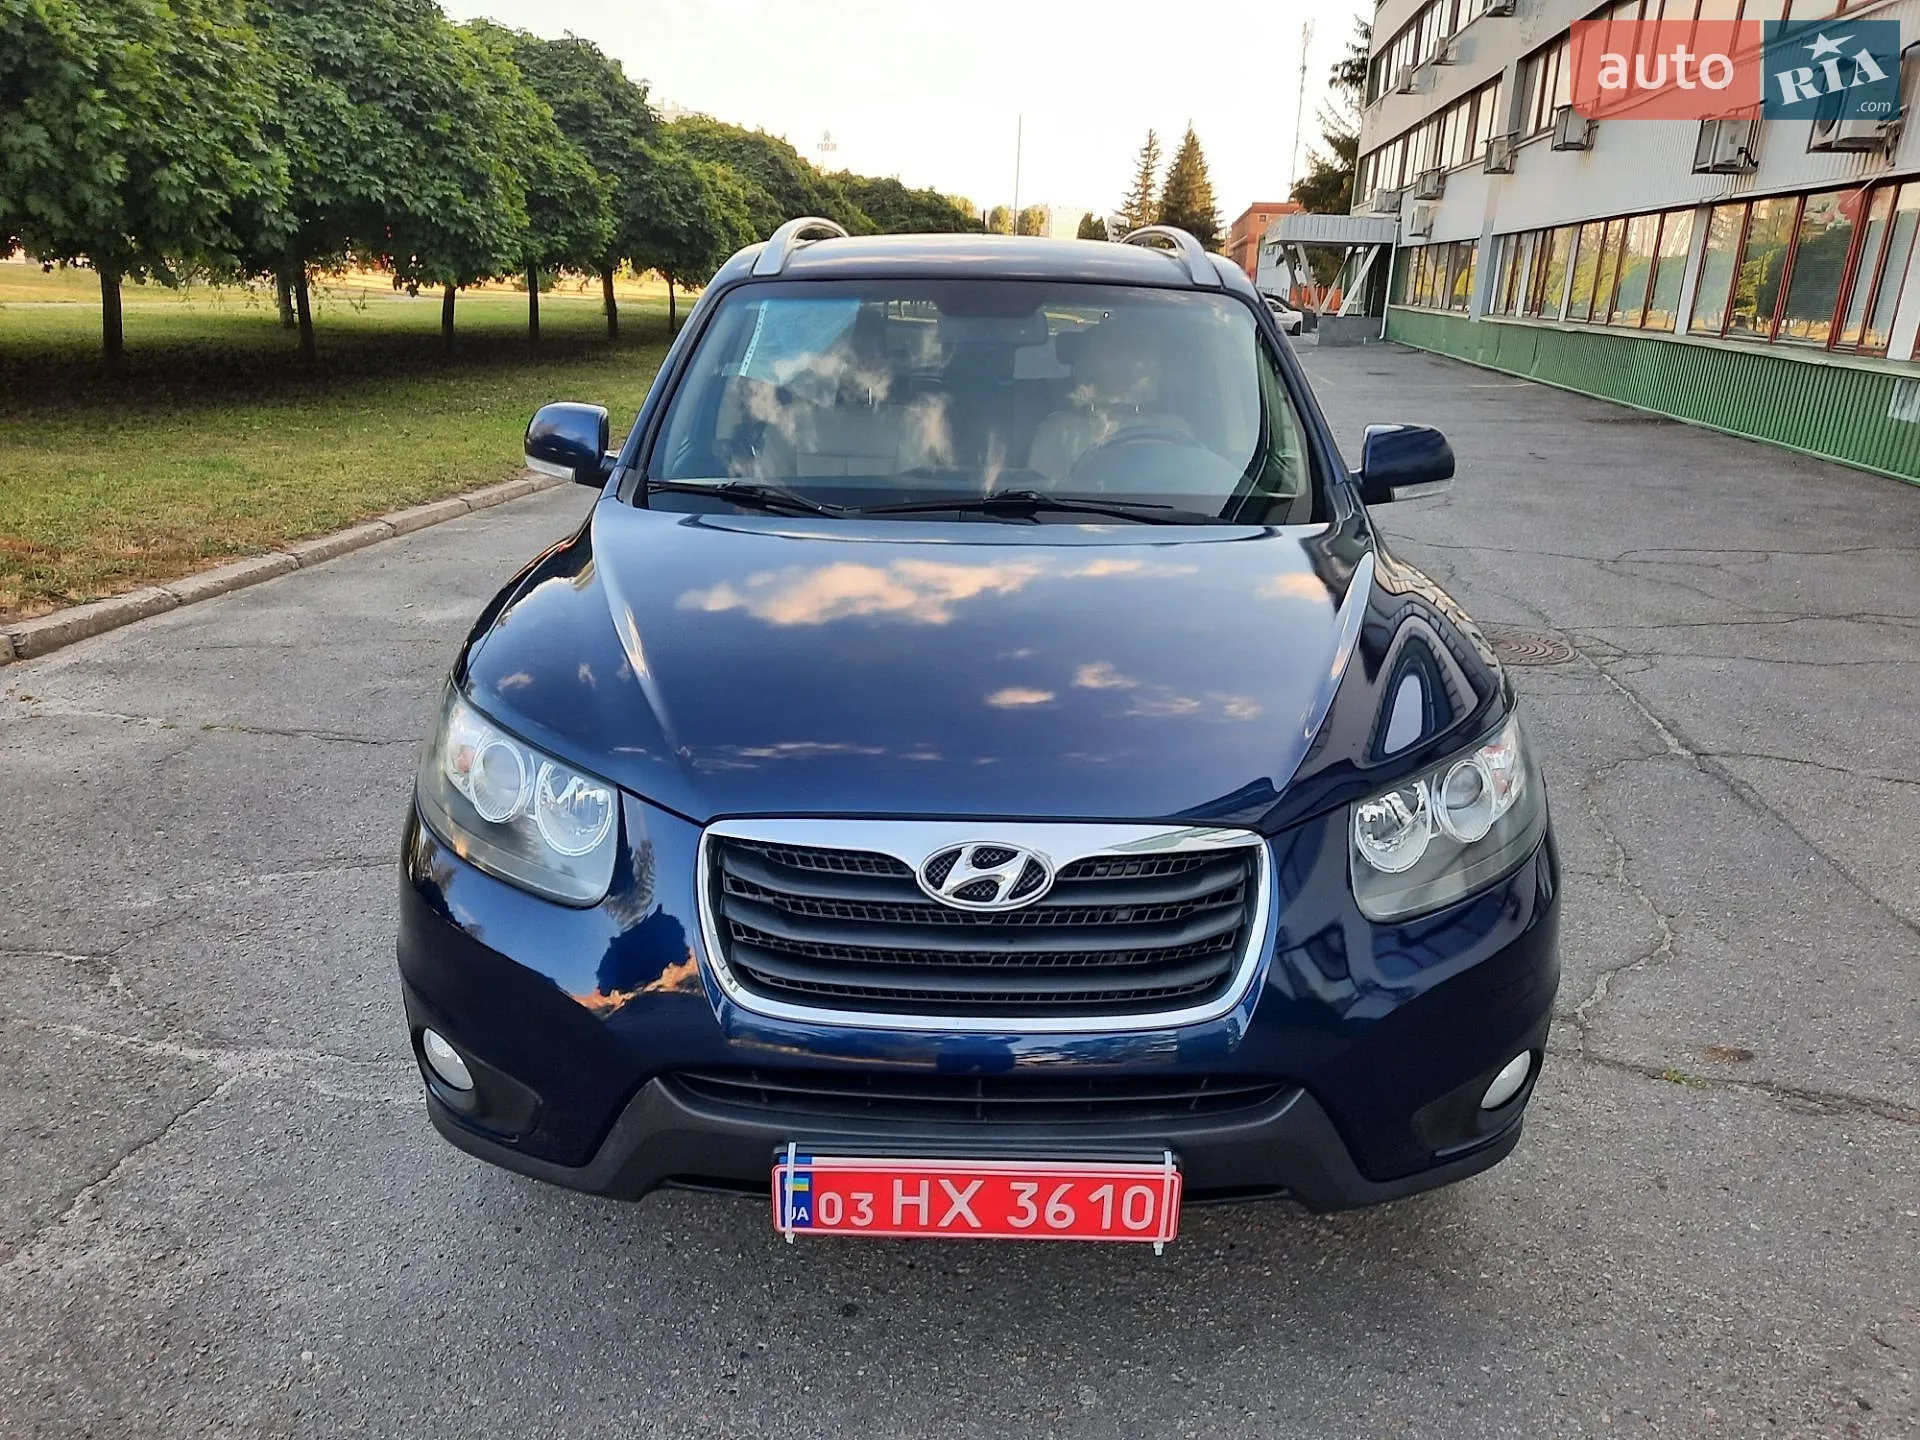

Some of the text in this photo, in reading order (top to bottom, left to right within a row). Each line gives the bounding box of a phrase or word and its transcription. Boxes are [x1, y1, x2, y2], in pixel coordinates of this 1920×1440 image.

[818, 1179, 1156, 1231] 03 HX 3610
